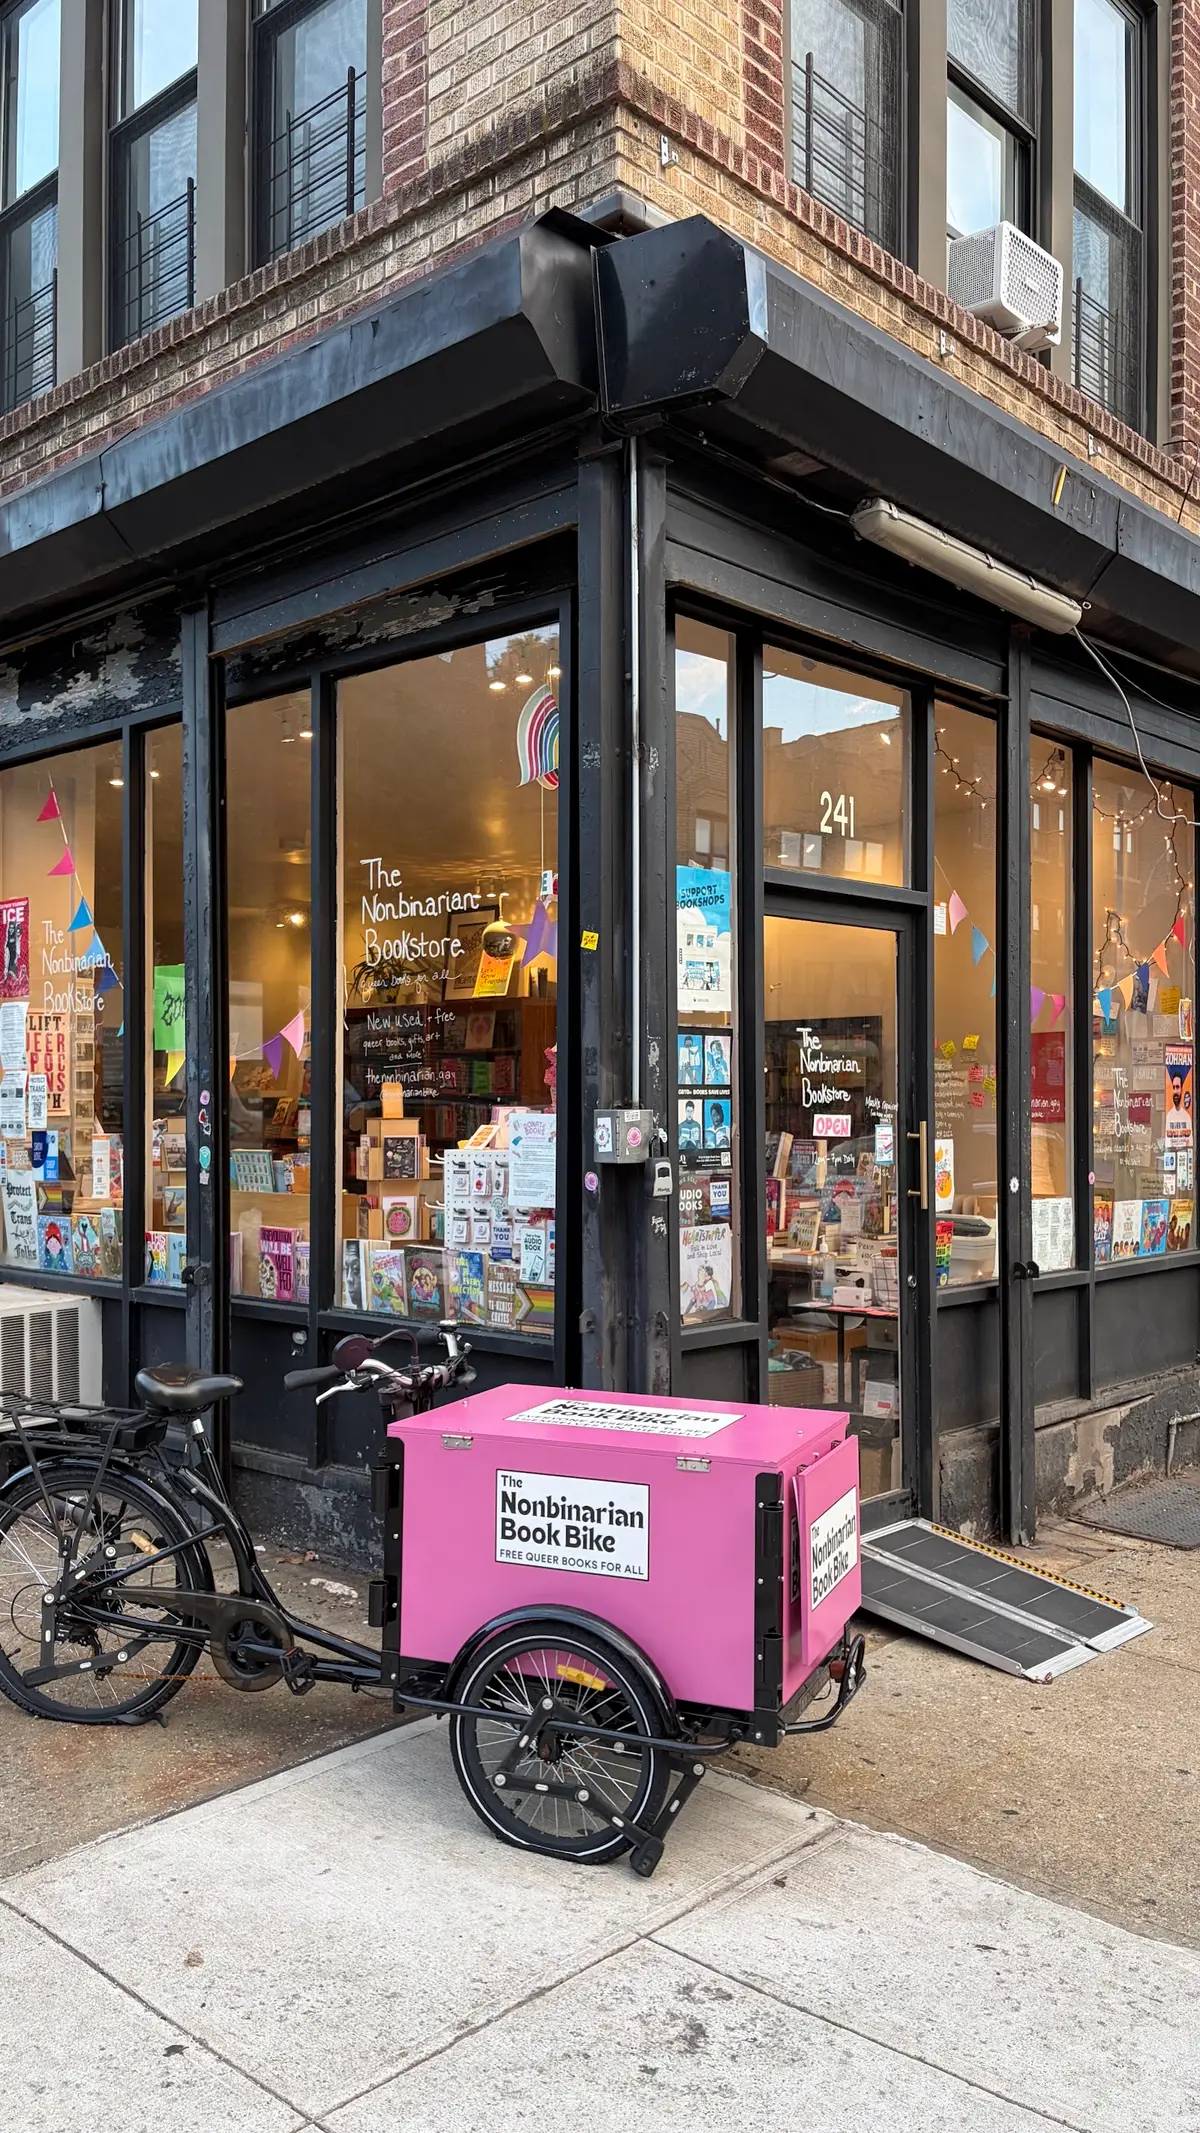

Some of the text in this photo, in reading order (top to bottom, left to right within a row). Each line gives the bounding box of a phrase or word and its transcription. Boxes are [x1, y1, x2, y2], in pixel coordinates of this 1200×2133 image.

[820, 791, 854, 838] 241
[360, 857, 402, 890] The
[681, 884, 717, 899] SUPPORT
[362, 891, 479, 924] Nonbinarian
[676, 894, 725, 911] BOOKSHOPS
[2, 906, 25, 925] ICE
[42, 920, 64, 944] The
[365, 928, 465, 966] Bookstore
[42, 946, 114, 975] Nonbinarian
[360, 969, 462, 1003] queer books for all
[43, 981, 104, 1017] Bookstore
[27, 1014, 62, 1031] LIFT
[434, 1007, 456, 1024] free
[362, 1033, 440, 1057] queer books, gifts, art
[796, 1027, 822, 1050] The
[389, 1049, 426, 1061] and more!
[799, 1047, 861, 1075] Nonbinarian
[1165, 1053, 1192, 1066] ZOHRAN
[365, 1067, 456, 1088] thenonbinarian.gay
[1112, 1068, 1128, 1088] The
[801, 1077, 851, 1108] Bookstore
[1113, 1089, 1154, 1109] Nonbinarian
[865, 1095, 880, 1110] Masks
[1031, 1096, 1060, 1113] narian.gay
[523, 1121, 546, 1129] DONATE
[524, 1127, 546, 1136] BOOKS
[815, 1117, 849, 1136] OPEN
[1114, 1113, 1147, 1137] Bookstore
[830, 1153, 842, 1167] 7pm
[6, 1182, 32, 1198] Protect
[680, 1188, 702, 1200] UDIO
[712, 1190, 727, 1198] YOU
[679, 1200, 703, 1211] OOKS
[10, 1211, 33, 1225] Trans
[494, 1232, 509, 1241] YOU
[524, 1237, 542, 1245] AUDIO
[682, 1227, 726, 1247] HEARTSTOPPER
[14, 1244, 37, 1261] Folks
[260, 1241, 292, 1255] WILL BE
[525, 1243, 541, 1252] BOOK
[687, 1249, 722, 1260] and Shop Local
[691, 1244, 700, 1252] Fall
[275, 1255, 292, 1273] WELL
[279, 1272, 292, 1291] FED
[488, 1280, 514, 1294] MESSAGE
[491, 1312, 510, 1323] COATES
[514, 1417, 600, 1427] THEMSELVES
[518, 1414, 588, 1423] EVERYONE
[589, 1420, 660, 1429] DESERVES
[540, 1408, 677, 1425] Book Bike
[553, 1404, 720, 1423] Nonbinarian
[501, 1474, 523, 1488] The
[501, 1490, 644, 1529] Nonbinarian
[500, 1517, 616, 1553] Book Bike
[811, 1525, 820, 1541] The
[812, 1513, 856, 1573] Nonbinarian
[500, 1549, 644, 1575] FREE QUEER BOOKS FOR ALL
[812, 1561, 833, 1604] Book
[833, 1550, 849, 1583] Bike
